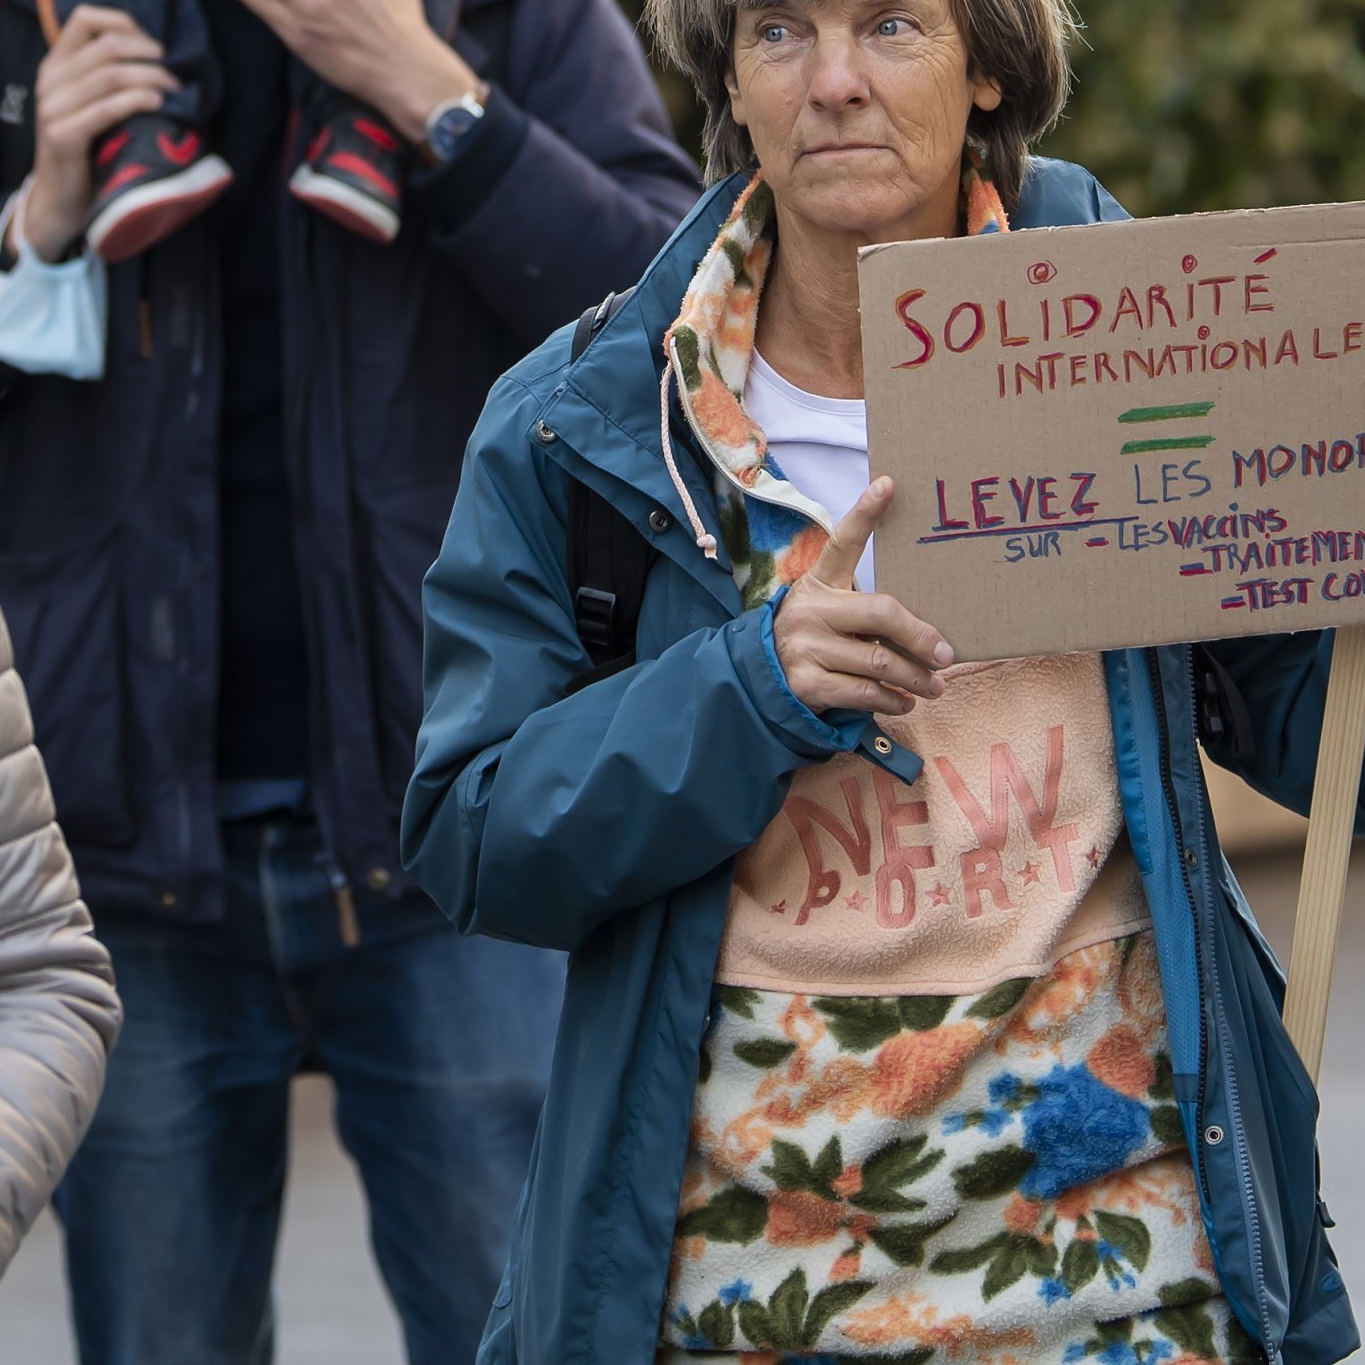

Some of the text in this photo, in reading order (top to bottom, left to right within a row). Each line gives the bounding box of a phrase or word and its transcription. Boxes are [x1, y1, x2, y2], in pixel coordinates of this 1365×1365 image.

[891, 248, 1277, 370] SOLIDARITÉ
[998, 322, 1365, 398] INTERNATIONALE
[933, 472, 1100, 531] LEVEZ
[1136, 460, 1212, 505] LES
[1005, 533, 1062, 563] SUR
[783, 724, 1065, 877] NEW
